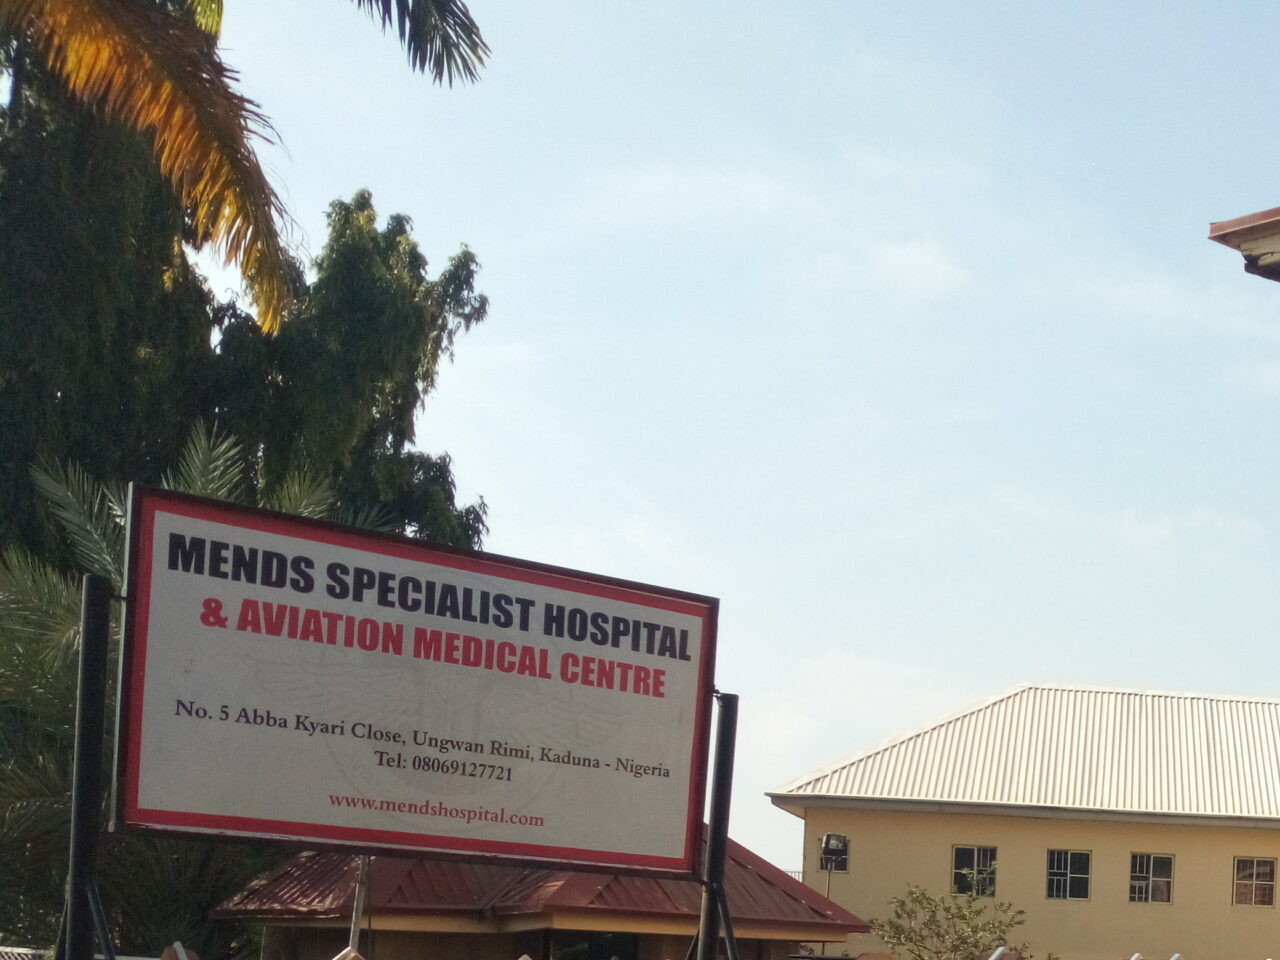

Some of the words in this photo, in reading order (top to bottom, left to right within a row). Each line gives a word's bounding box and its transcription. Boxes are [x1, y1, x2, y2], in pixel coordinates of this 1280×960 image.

[168, 532, 315, 594] MENDS
[326, 562, 536, 632] SPECIALIST
[543, 603, 692, 661] HOSPITAL
[199, 597, 228, 629] &
[236, 598, 404, 656] AVIATION
[413, 626, 552, 680] MEDICAL
[560, 652, 666, 698] CENTRE
[174, 699, 213, 720] No.
[219, 705, 230, 721] 5
[234, 707, 288, 729] Abba
[294, 714, 345, 736] Kyari
[351, 722, 406, 747] Close,
[413, 730, 484, 754] Ungwan
[490, 741, 535, 763] Rimi,
[540, 747, 600, 769] Kaduna
[615, 757, 671, 778] Nigeria
[374, 750, 407, 770] Tel:
[412, 755, 513, 782] 08069127721
[328, 793, 544, 827] www.mendshospital.com
